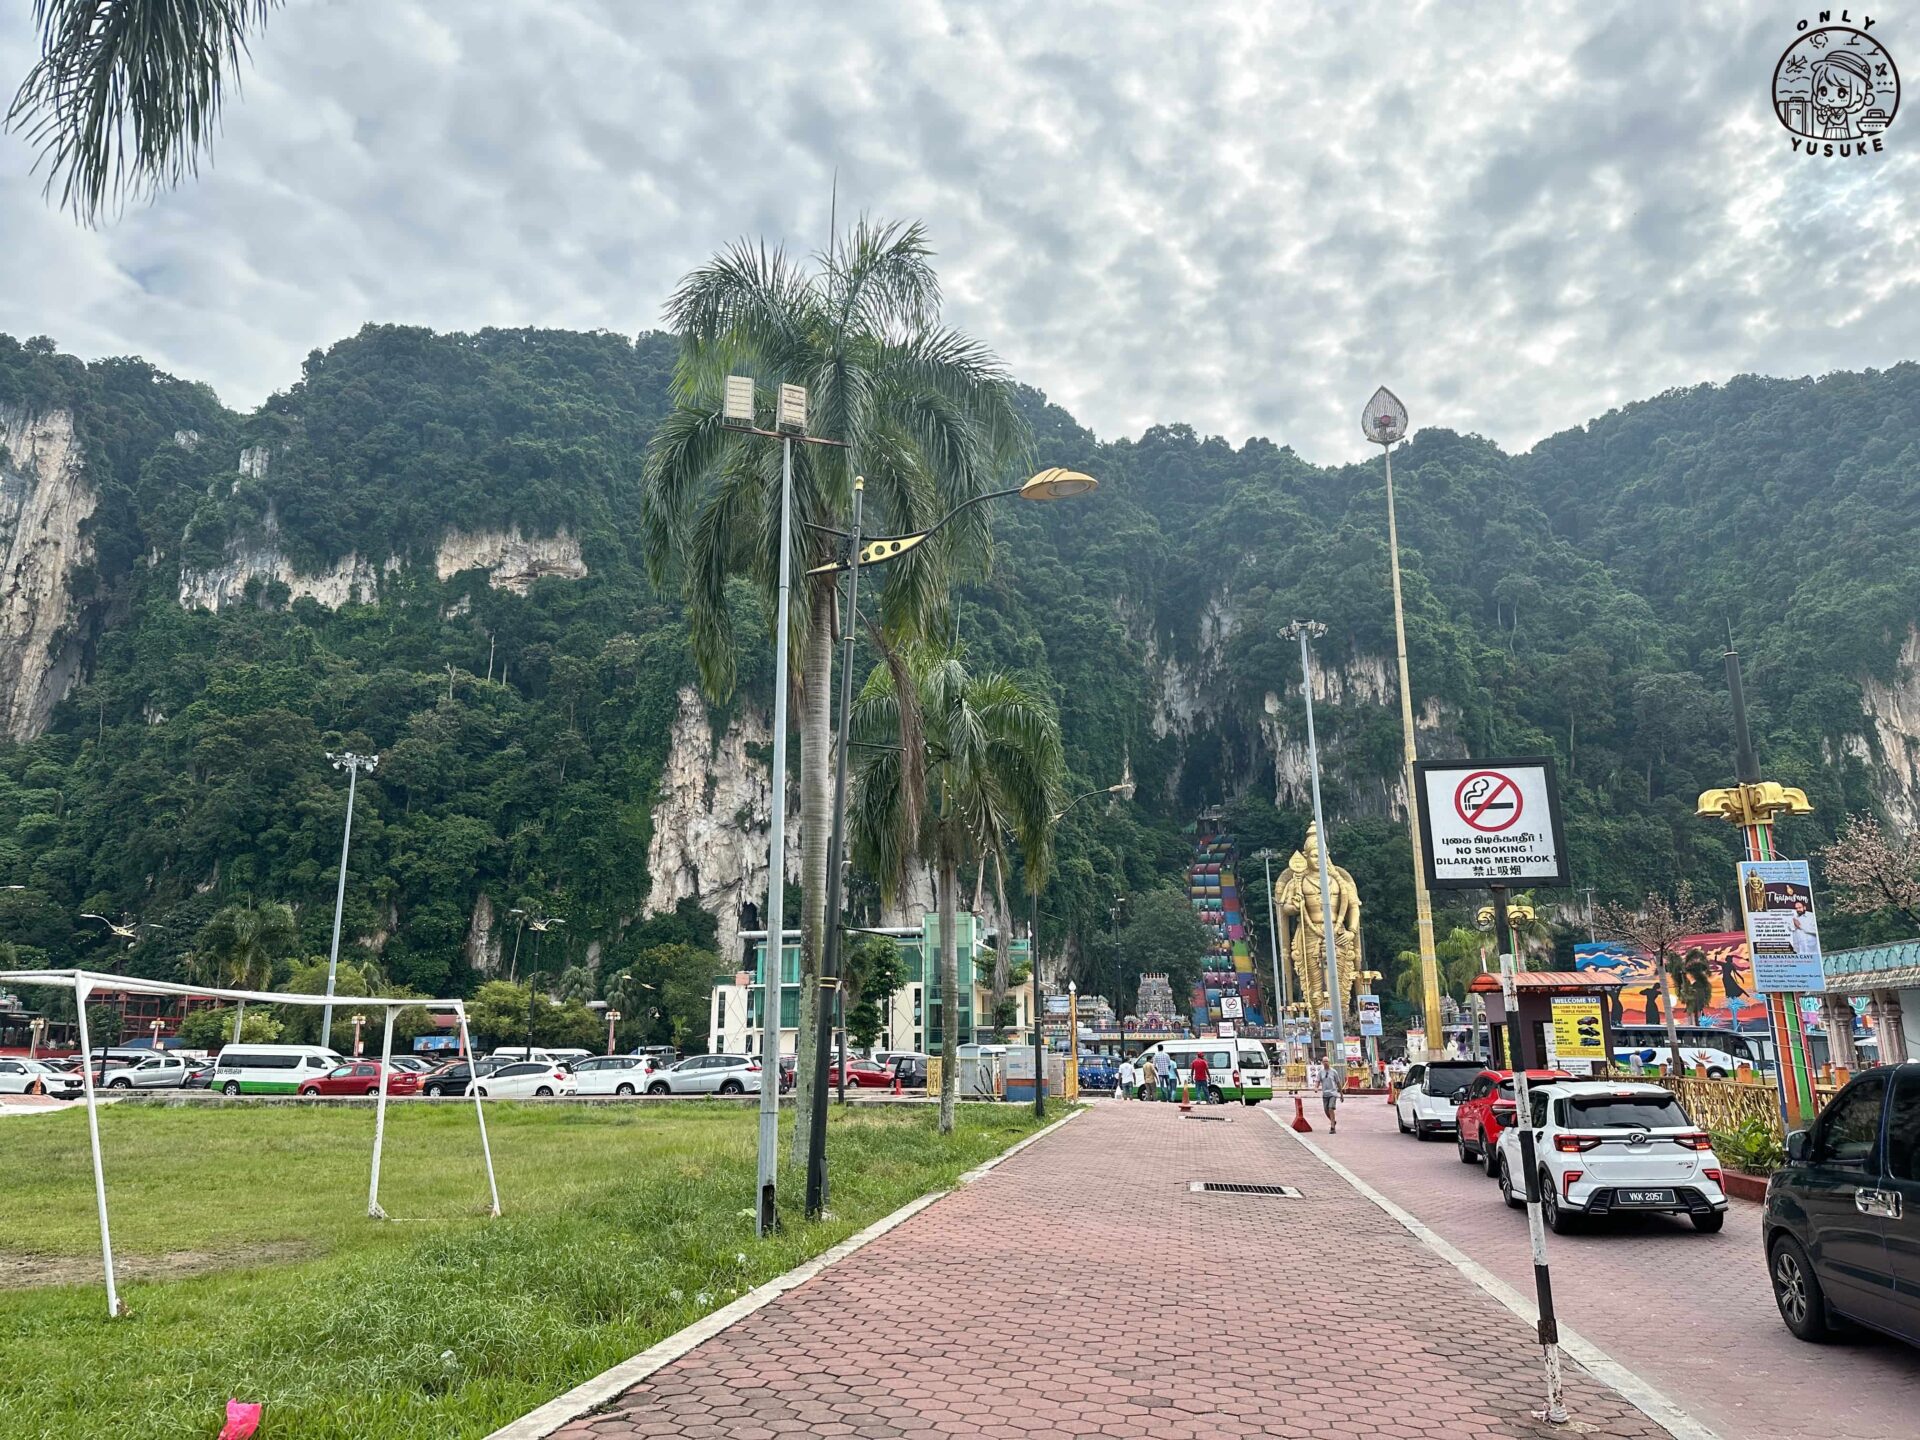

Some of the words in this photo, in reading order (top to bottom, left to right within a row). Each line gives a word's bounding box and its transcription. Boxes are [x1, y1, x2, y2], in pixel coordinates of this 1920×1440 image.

[1475, 845, 1526, 854] SMOKING
[1436, 857, 1491, 865] DILARANG
[1494, 856, 1550, 864] MEROKOK
[1473, 866, 1522, 876] 禁止吸烟
[1629, 1192, 1643, 1200] VKK
[1645, 1192, 1663, 1201] 2057
